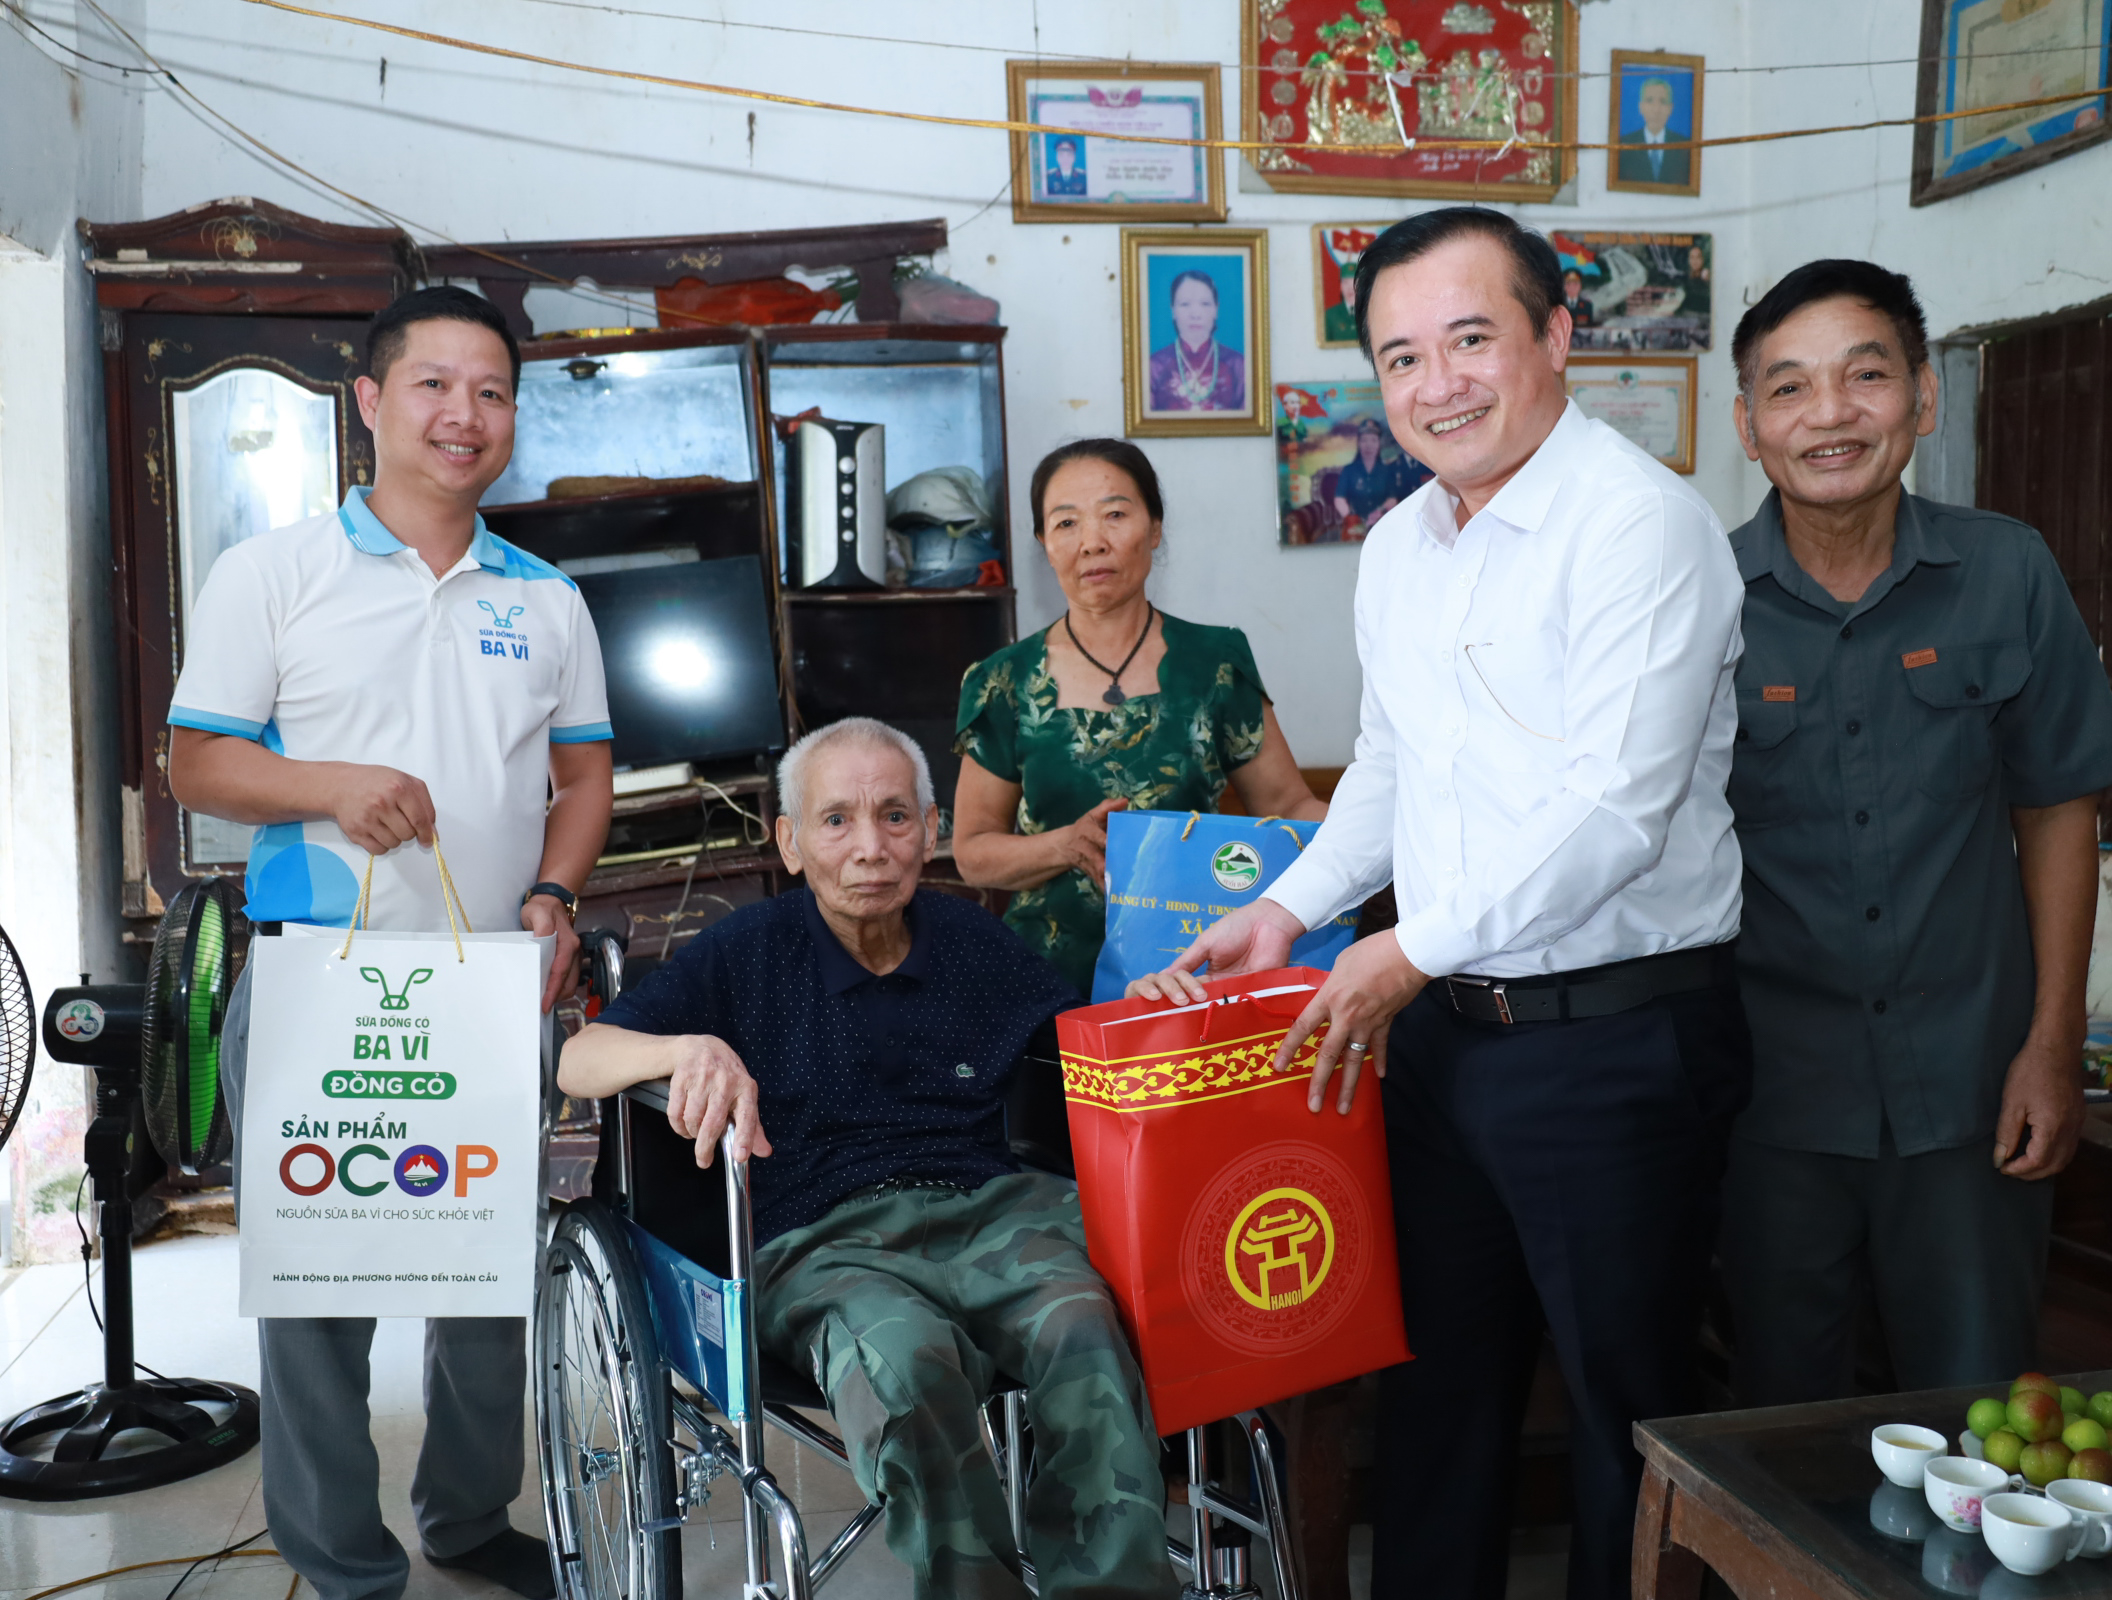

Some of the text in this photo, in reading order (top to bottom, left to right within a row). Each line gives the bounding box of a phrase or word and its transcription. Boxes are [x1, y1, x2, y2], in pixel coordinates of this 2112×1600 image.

[480, 639, 529, 661] BA VÌ
[1765, 688, 1792, 698] fashion
[1110, 892, 1140, 907] ĐẢNG
[1165, 900, 1199, 913] HĐND
[1179, 918, 1203, 935] XÃ
[355, 1015, 377, 1027] SỮA
[353, 1030, 431, 1061] BA VÌ
[330, 1071, 446, 1095] ĐỒNG CỎ
[281, 1112, 407, 1139] SẢN PHẨM
[279, 1143, 498, 1198] OCOP
[324, 1206, 349, 1219] SỮA
[351, 1209, 367, 1219] BA
[369, 1207, 381, 1219] VÌ
[383, 1209, 410, 1220] CHO
[412, 1207, 435, 1220] SỨC
[438, 1207, 470, 1220] KHỎE
[472, 1208, 495, 1222] VIỆT
[272, 1272, 300, 1282] HÀNH
[302, 1273, 330, 1284] ĐỘNG
[333, 1275, 350, 1284] ĐỊA
[352, 1274, 392, 1282] PHƯƠNG
[394, 1273, 429, 1282] HƯỚNG
[431, 1272, 449, 1282] ĐẾN
[451, 1273, 476, 1282] TOÀN
[1270, 1289, 1302, 1311] HANOI
